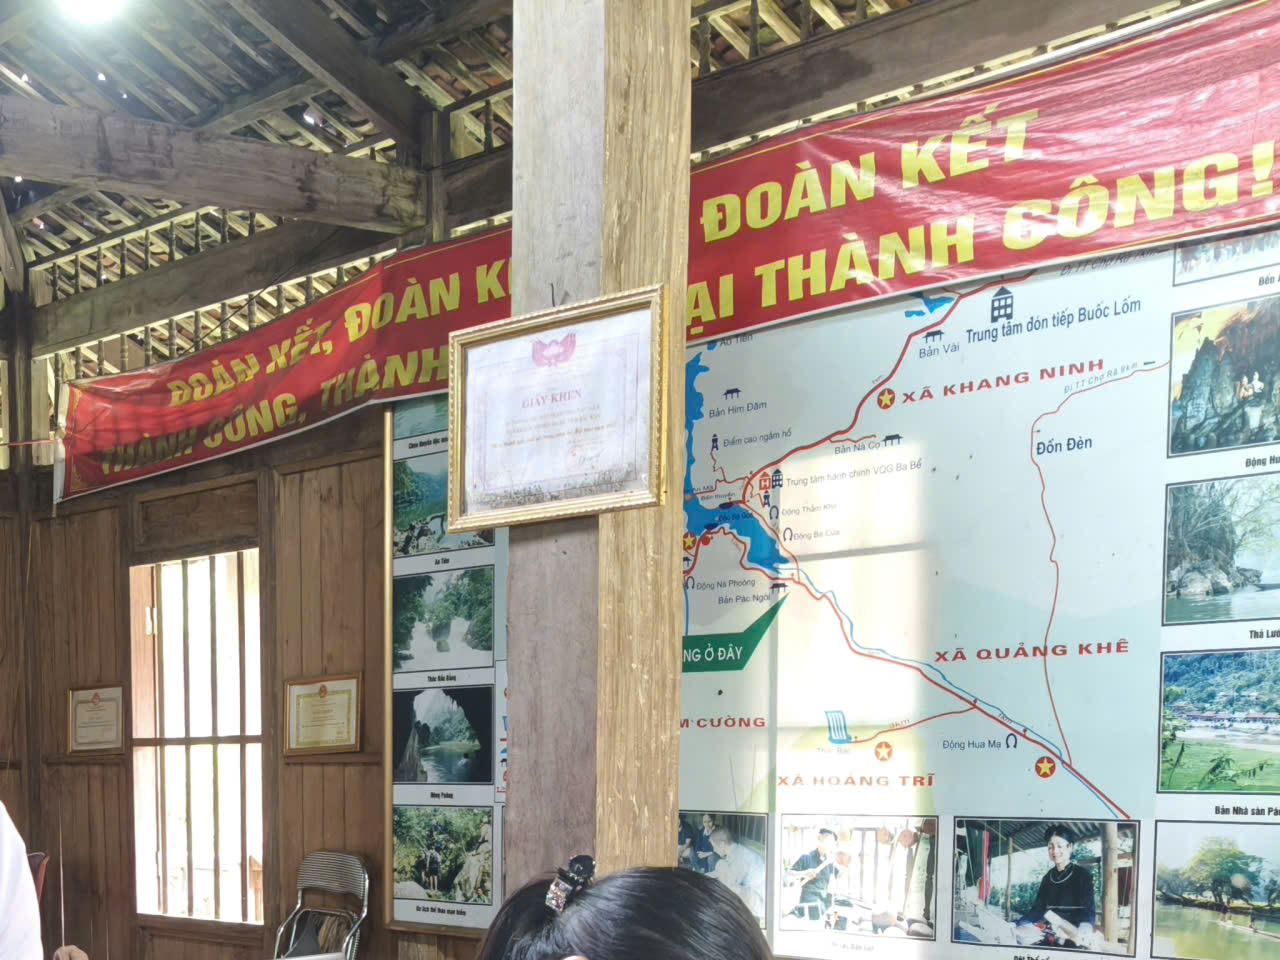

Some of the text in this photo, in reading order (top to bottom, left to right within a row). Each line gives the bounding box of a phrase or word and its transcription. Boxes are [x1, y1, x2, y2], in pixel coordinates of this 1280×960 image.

[344, 272, 461, 343] ĐOÀN
[700, 152, 876, 243] ĐOÀN
[900, 104, 1039, 189] KẾT
[322, 348, 449, 411] THÀNH
[687, 273, 734, 336] ẠI
[754, 215, 975, 309] THÀNH
[1001, 140, 1276, 251] CÔNG!
[966, 327, 999, 343] Trung
[1002, 321, 1022, 336] tâm
[1026, 315, 1048, 332] đón
[1052, 307, 1074, 328] tiếp
[919, 346, 939, 358] Bản
[902, 358, 1104, 404] XÃ KHANG NINH
[1066, 436, 1093, 451] Đèn
[683, 643, 743, 662] NG Ở ĐÂY
[934, 638, 1129, 662] XÃ QUẢNG KHÊ
[696, 715, 766, 728] CƯỜNG
[942, 740, 965, 750] Động
[968, 740, 986, 749] Hua
[778, 774, 803, 786] XÃ
